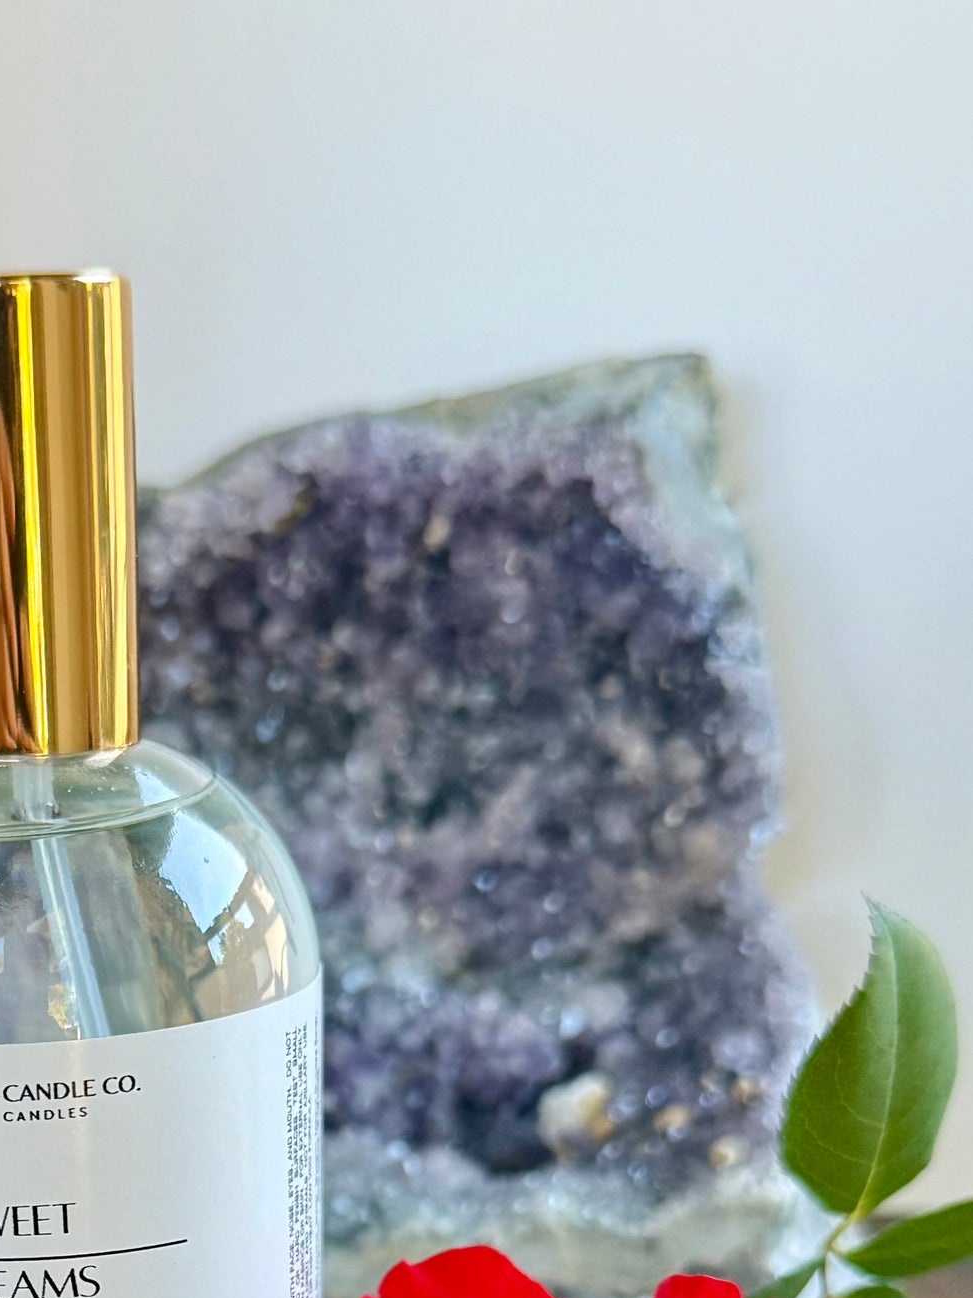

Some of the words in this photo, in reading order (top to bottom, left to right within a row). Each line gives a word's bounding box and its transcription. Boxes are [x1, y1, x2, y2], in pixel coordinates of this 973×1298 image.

[286, 1060, 292, 1078] DO
[2, 1079, 96, 1102] CANDLE
[102, 1075, 141, 1095] CO.
[3, 1107, 88, 1122] CANDLES
